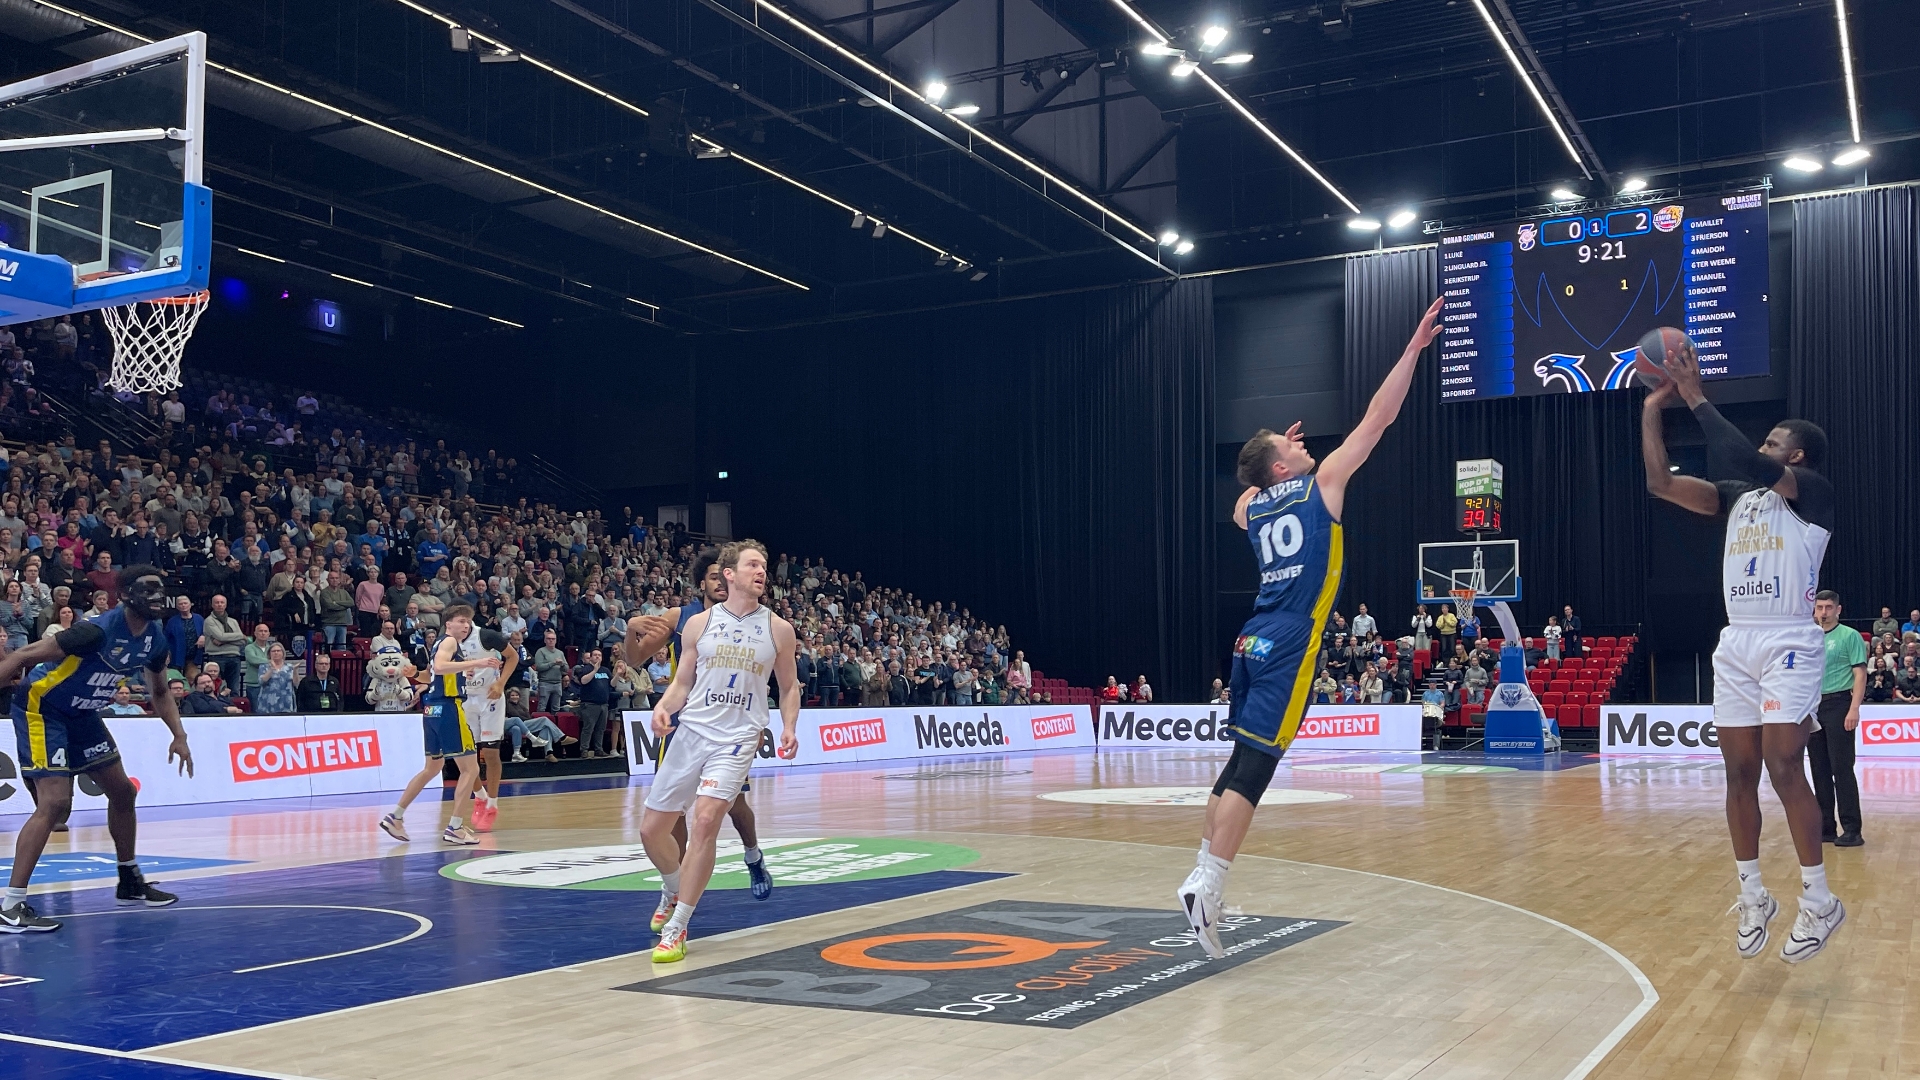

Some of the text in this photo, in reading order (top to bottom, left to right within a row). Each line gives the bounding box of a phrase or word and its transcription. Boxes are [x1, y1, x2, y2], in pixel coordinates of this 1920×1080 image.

[1722, 193, 1761, 206] LWD BASKET
[1569, 213, 1647, 239] 0 1 2
[1695, 218, 1724, 228] MAILLET
[1696, 231, 1729, 241] FRIERSON
[1448, 251, 1463, 259] LUKE
[1578, 240, 1627, 263] 9:21
[1696, 245, 1725, 255] MAIDOH
[1710, 258, 1736, 267] WEEME
[1696, 273, 1726, 282] MANUEL
[1448, 288, 1470, 297] MILLER
[1565, 279, 1629, 297] 0 1
[1697, 285, 1727, 295] BOUWER
[1762, 294, 1768, 302] 2
[1449, 300, 1472, 309] TAYLOR
[1697, 299, 1718, 308] PRYCE
[324, 312, 336, 328] U
[1688, 311, 1736, 323] 15 BRANDSMA
[1697, 326, 1723, 335] JANECK
[1449, 338, 1474, 347] GELLING
[1697, 340, 1722, 349] MERKX
[1697, 353, 1728, 362] FORSYTH
[1449, 364, 1470, 372] HOEVE
[1700, 367, 1728, 376] O'BOYLE
[1442, 376, 1473, 386] 22 NOSSEK
[1450, 388, 1476, 397] FORREST
[1459, 480, 1475, 490] KOP
[1463, 485, 1485, 495] VEUR
[1465, 497, 1490, 509] 9:21
[1257, 513, 1304, 565] 10
[1743, 556, 1758, 577] 4
[1781, 651, 1797, 670] 4
[725, 672, 739, 689] 1
[914, 712, 1010, 750] Meceda.
[1033, 716, 1074, 738] CONTENT
[822, 722, 883, 748] CONTENT
[729, 744, 743, 756] 1
[51, 747, 67, 768] 4
[237, 736, 373, 776] CONTENT
[913, 992, 1027, 1018] be
[1015, 947, 1175, 990] quality
[1025, 999, 1096, 1022] TESTING
[1095, 984, 1145, 998] DATA
